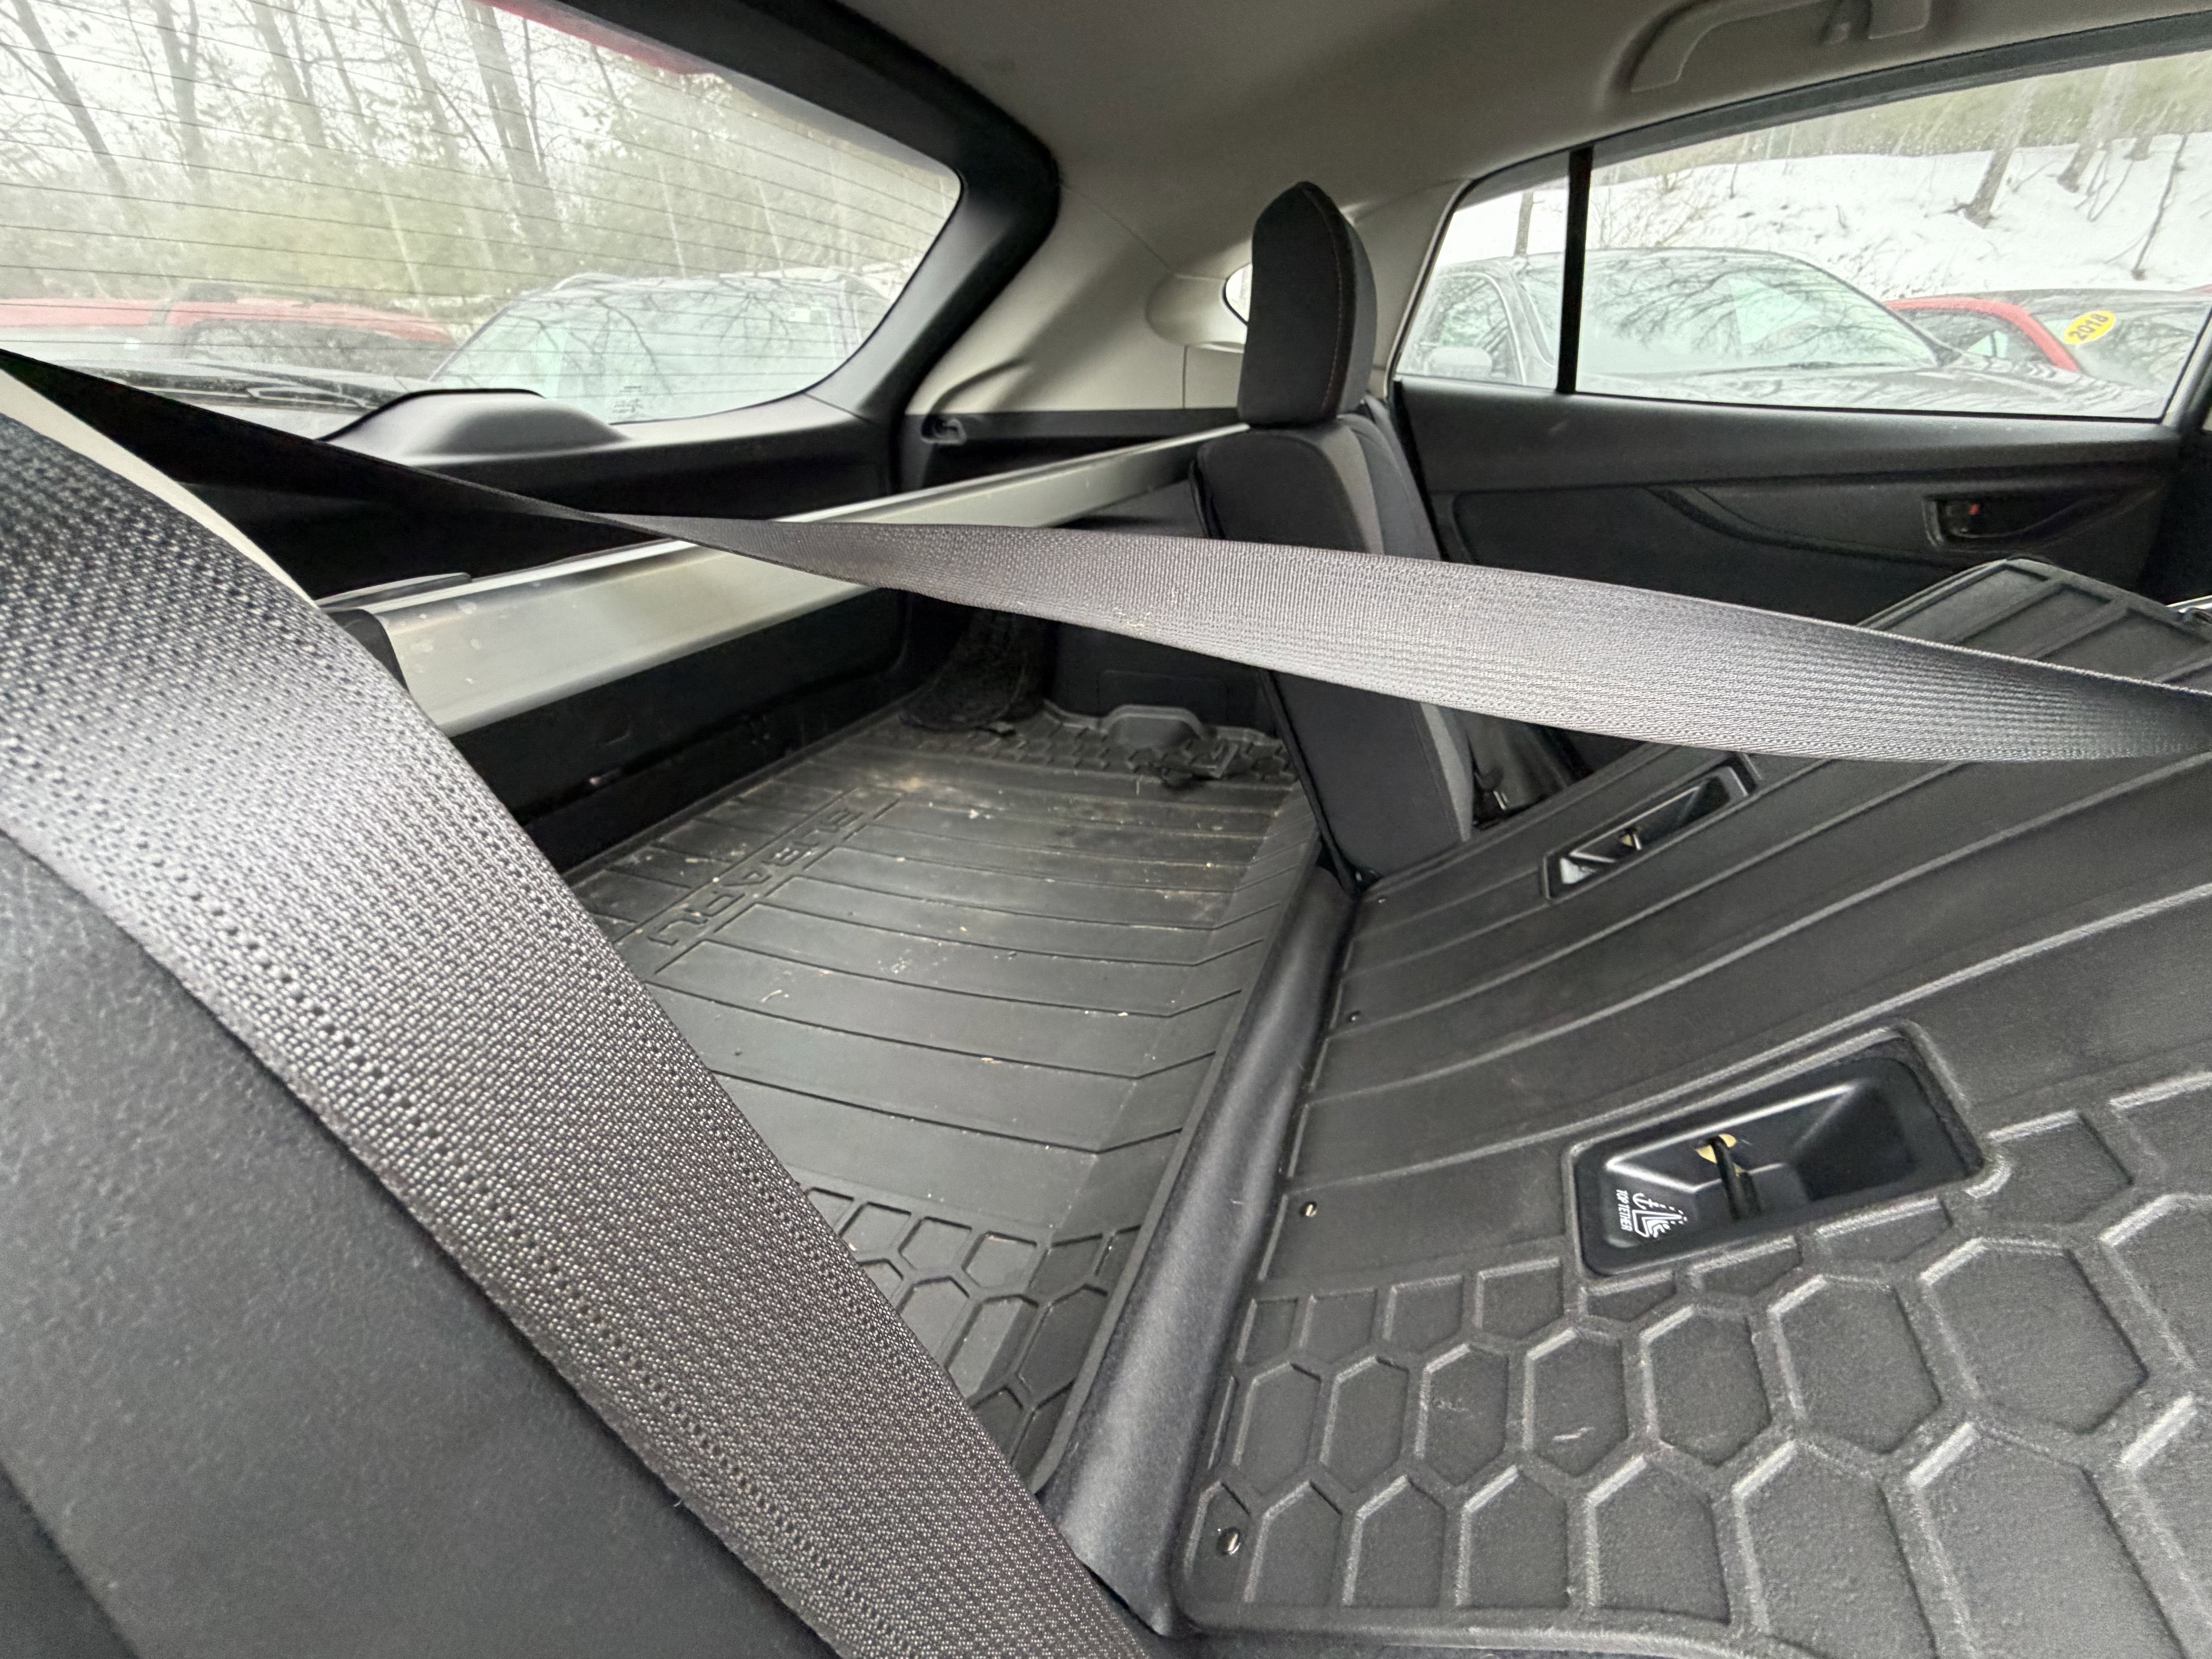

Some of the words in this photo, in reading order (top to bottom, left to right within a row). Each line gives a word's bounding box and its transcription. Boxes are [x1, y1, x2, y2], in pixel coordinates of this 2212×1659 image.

[2067, 313, 2109, 341] 2018
[646, 807, 864, 946] SUBARU
[1616, 1189, 1630, 1204] TOP
[1618, 1203, 1633, 1232] TETHER
